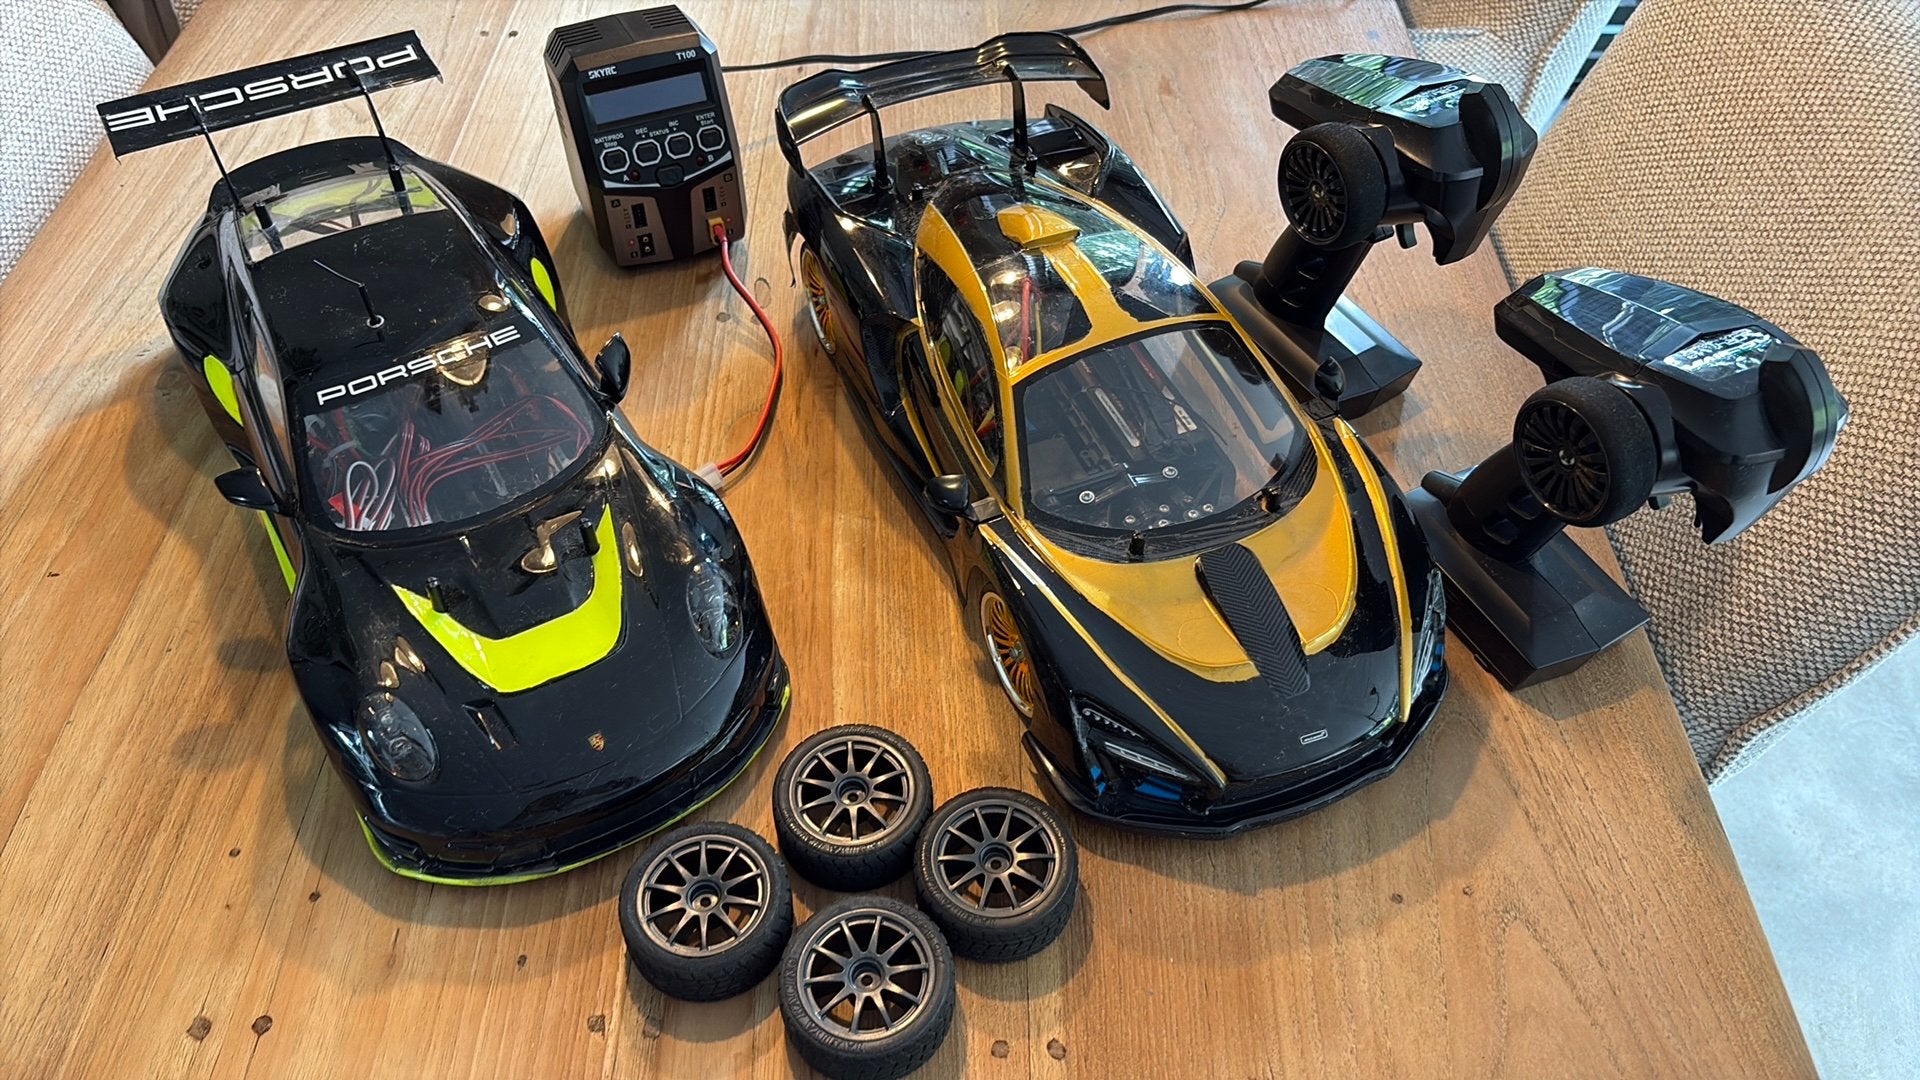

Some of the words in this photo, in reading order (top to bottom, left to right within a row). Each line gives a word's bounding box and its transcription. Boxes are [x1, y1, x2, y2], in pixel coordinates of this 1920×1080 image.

[676, 49, 696, 60] T100
[588, 66, 617, 79] SKYRC
[106, 44, 419, 132] PORSCHE
[695, 111, 716, 122] ENTER
[635, 127, 648, 135] DEC
[649, 128, 670, 138] STATUS
[316, 325, 521, 405] PORSCHE
